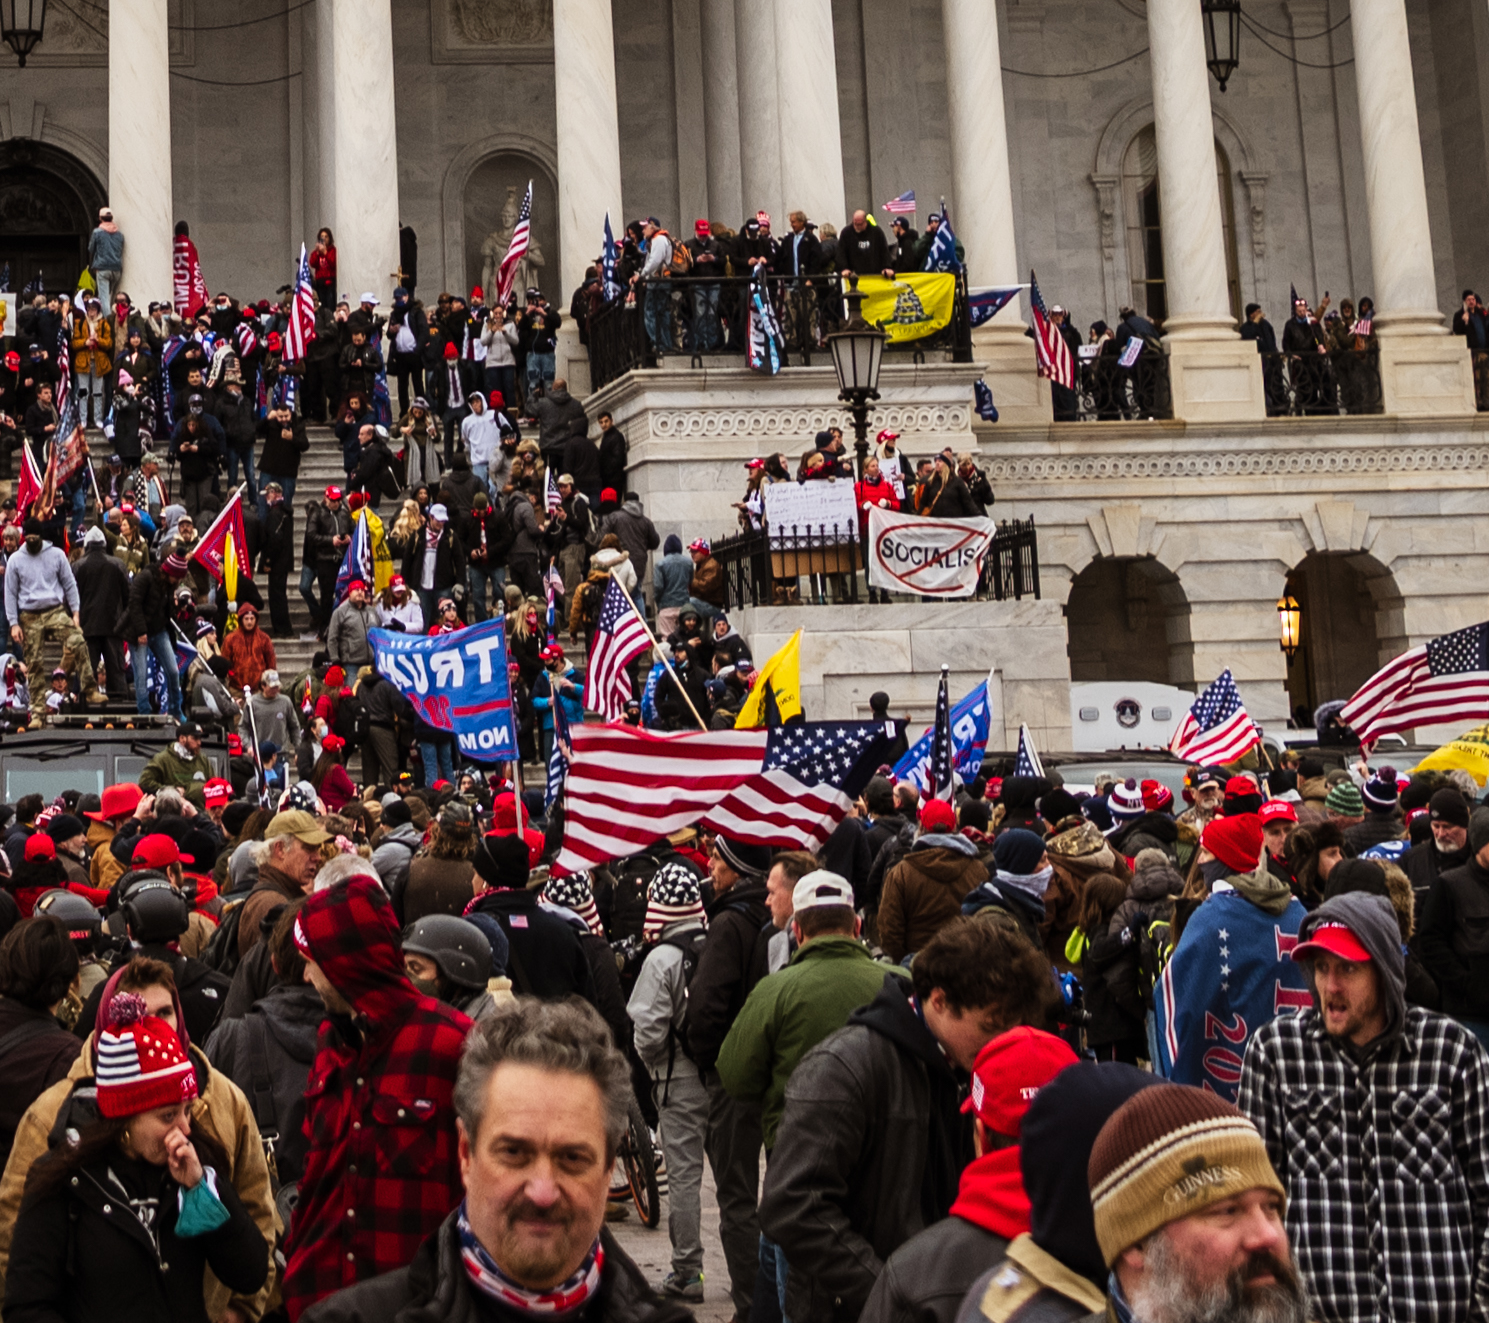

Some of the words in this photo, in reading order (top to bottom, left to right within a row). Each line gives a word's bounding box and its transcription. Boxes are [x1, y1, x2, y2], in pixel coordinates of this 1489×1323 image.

[881, 537, 978, 568] SOCIALIS
[1203, 1011, 1248, 1104] 20
[1163, 1165, 1243, 1205] GUINNESS
